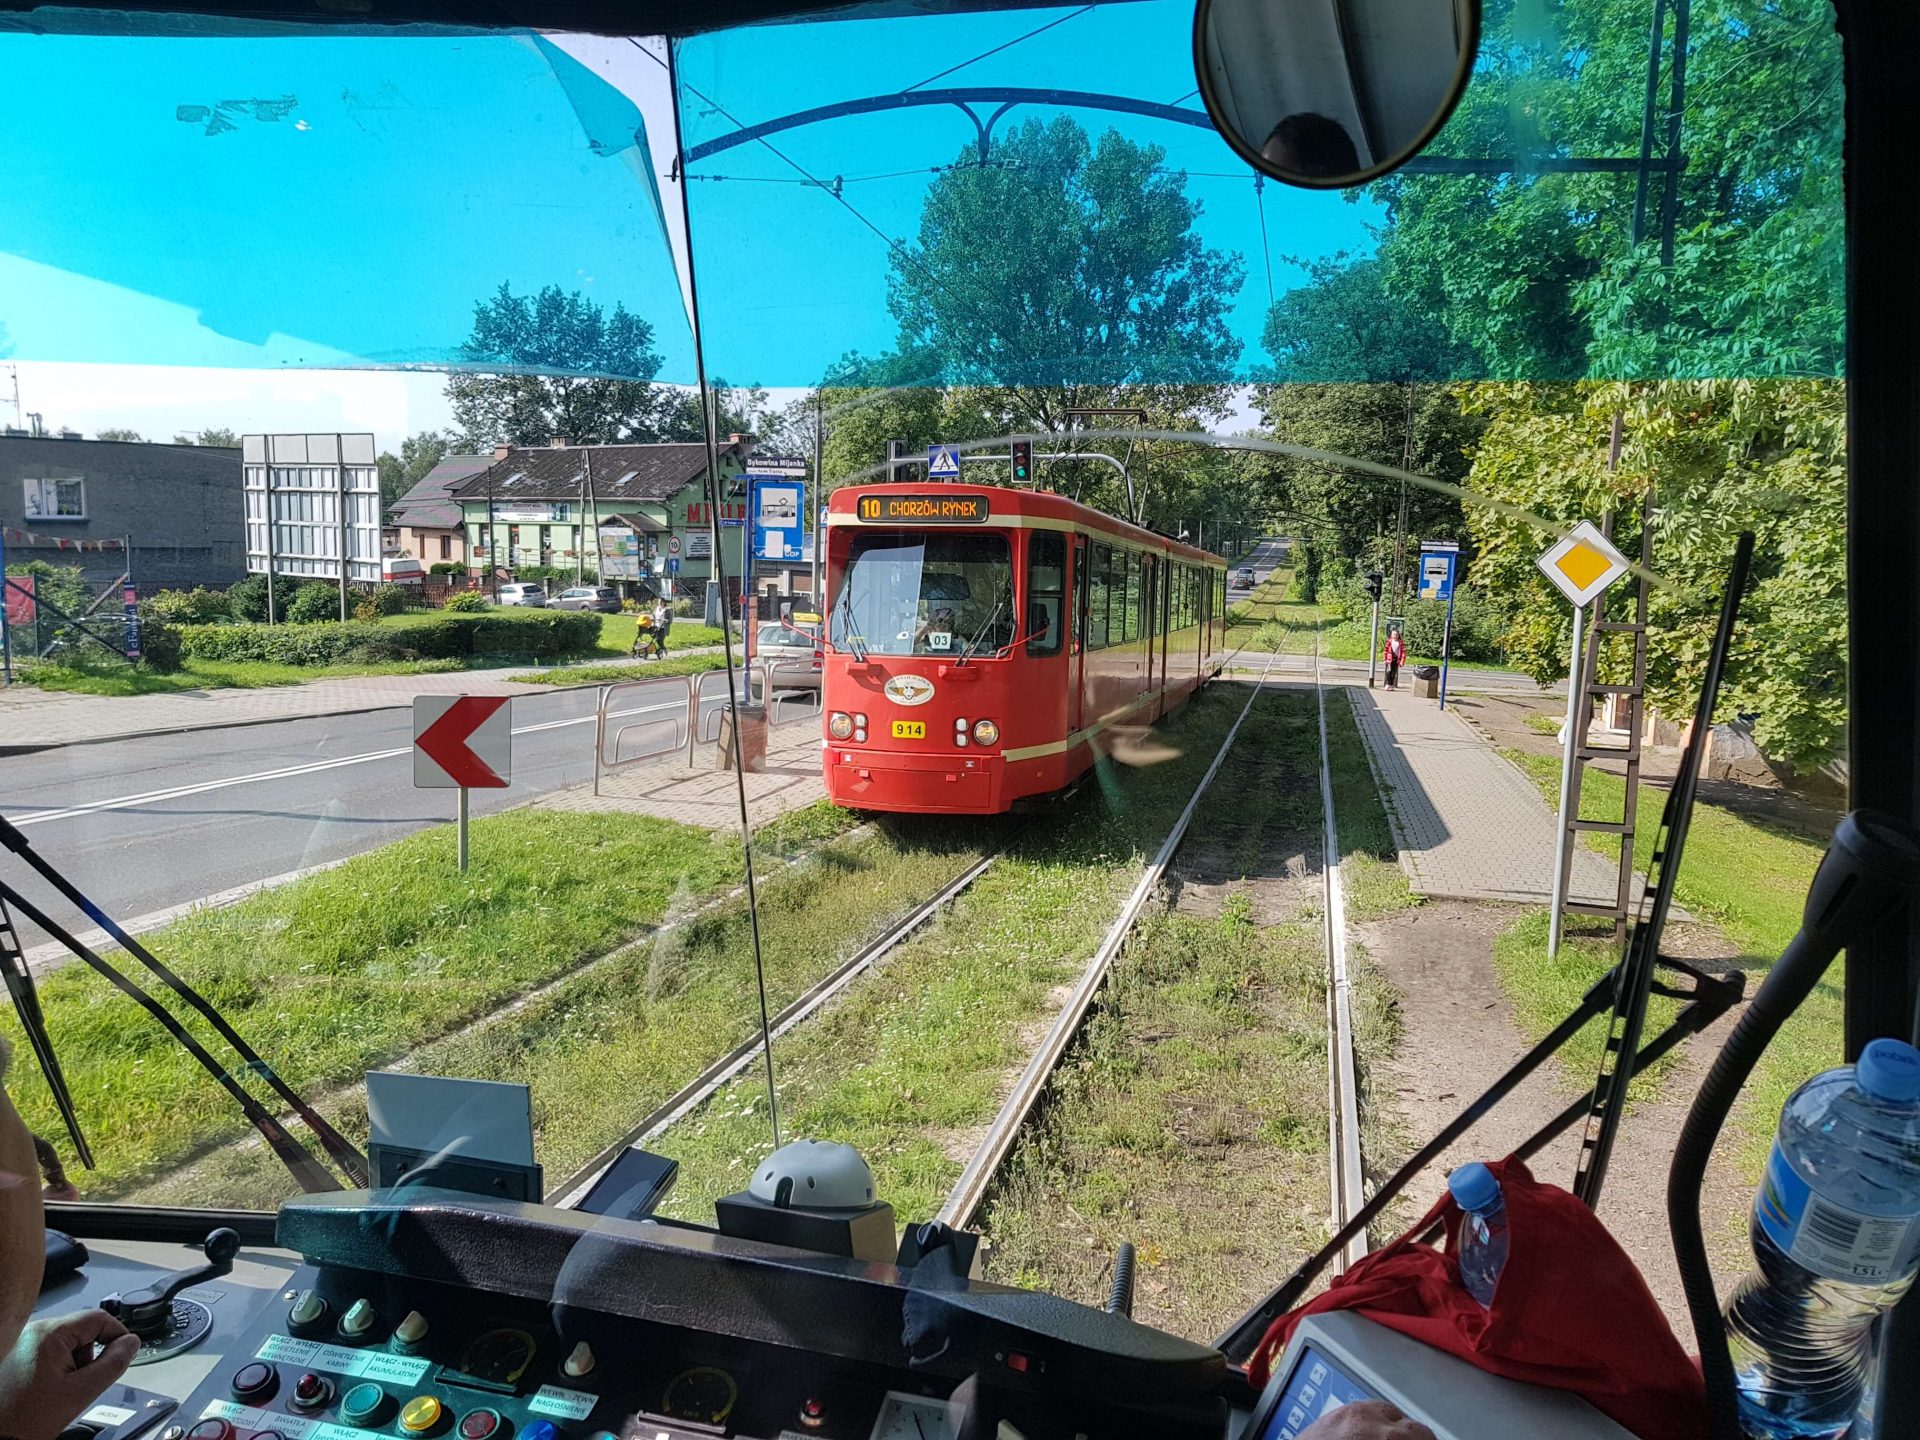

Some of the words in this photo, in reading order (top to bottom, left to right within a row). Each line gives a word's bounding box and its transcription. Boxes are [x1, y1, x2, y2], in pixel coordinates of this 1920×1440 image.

[780, 459, 805, 468] Mijanka
[861, 499, 881, 518] 10
[889, 499, 939, 517] CHORZÓW
[941, 501, 977, 517] RYNEK
[934, 635, 948, 646] 03
[896, 724, 922, 736] 914
